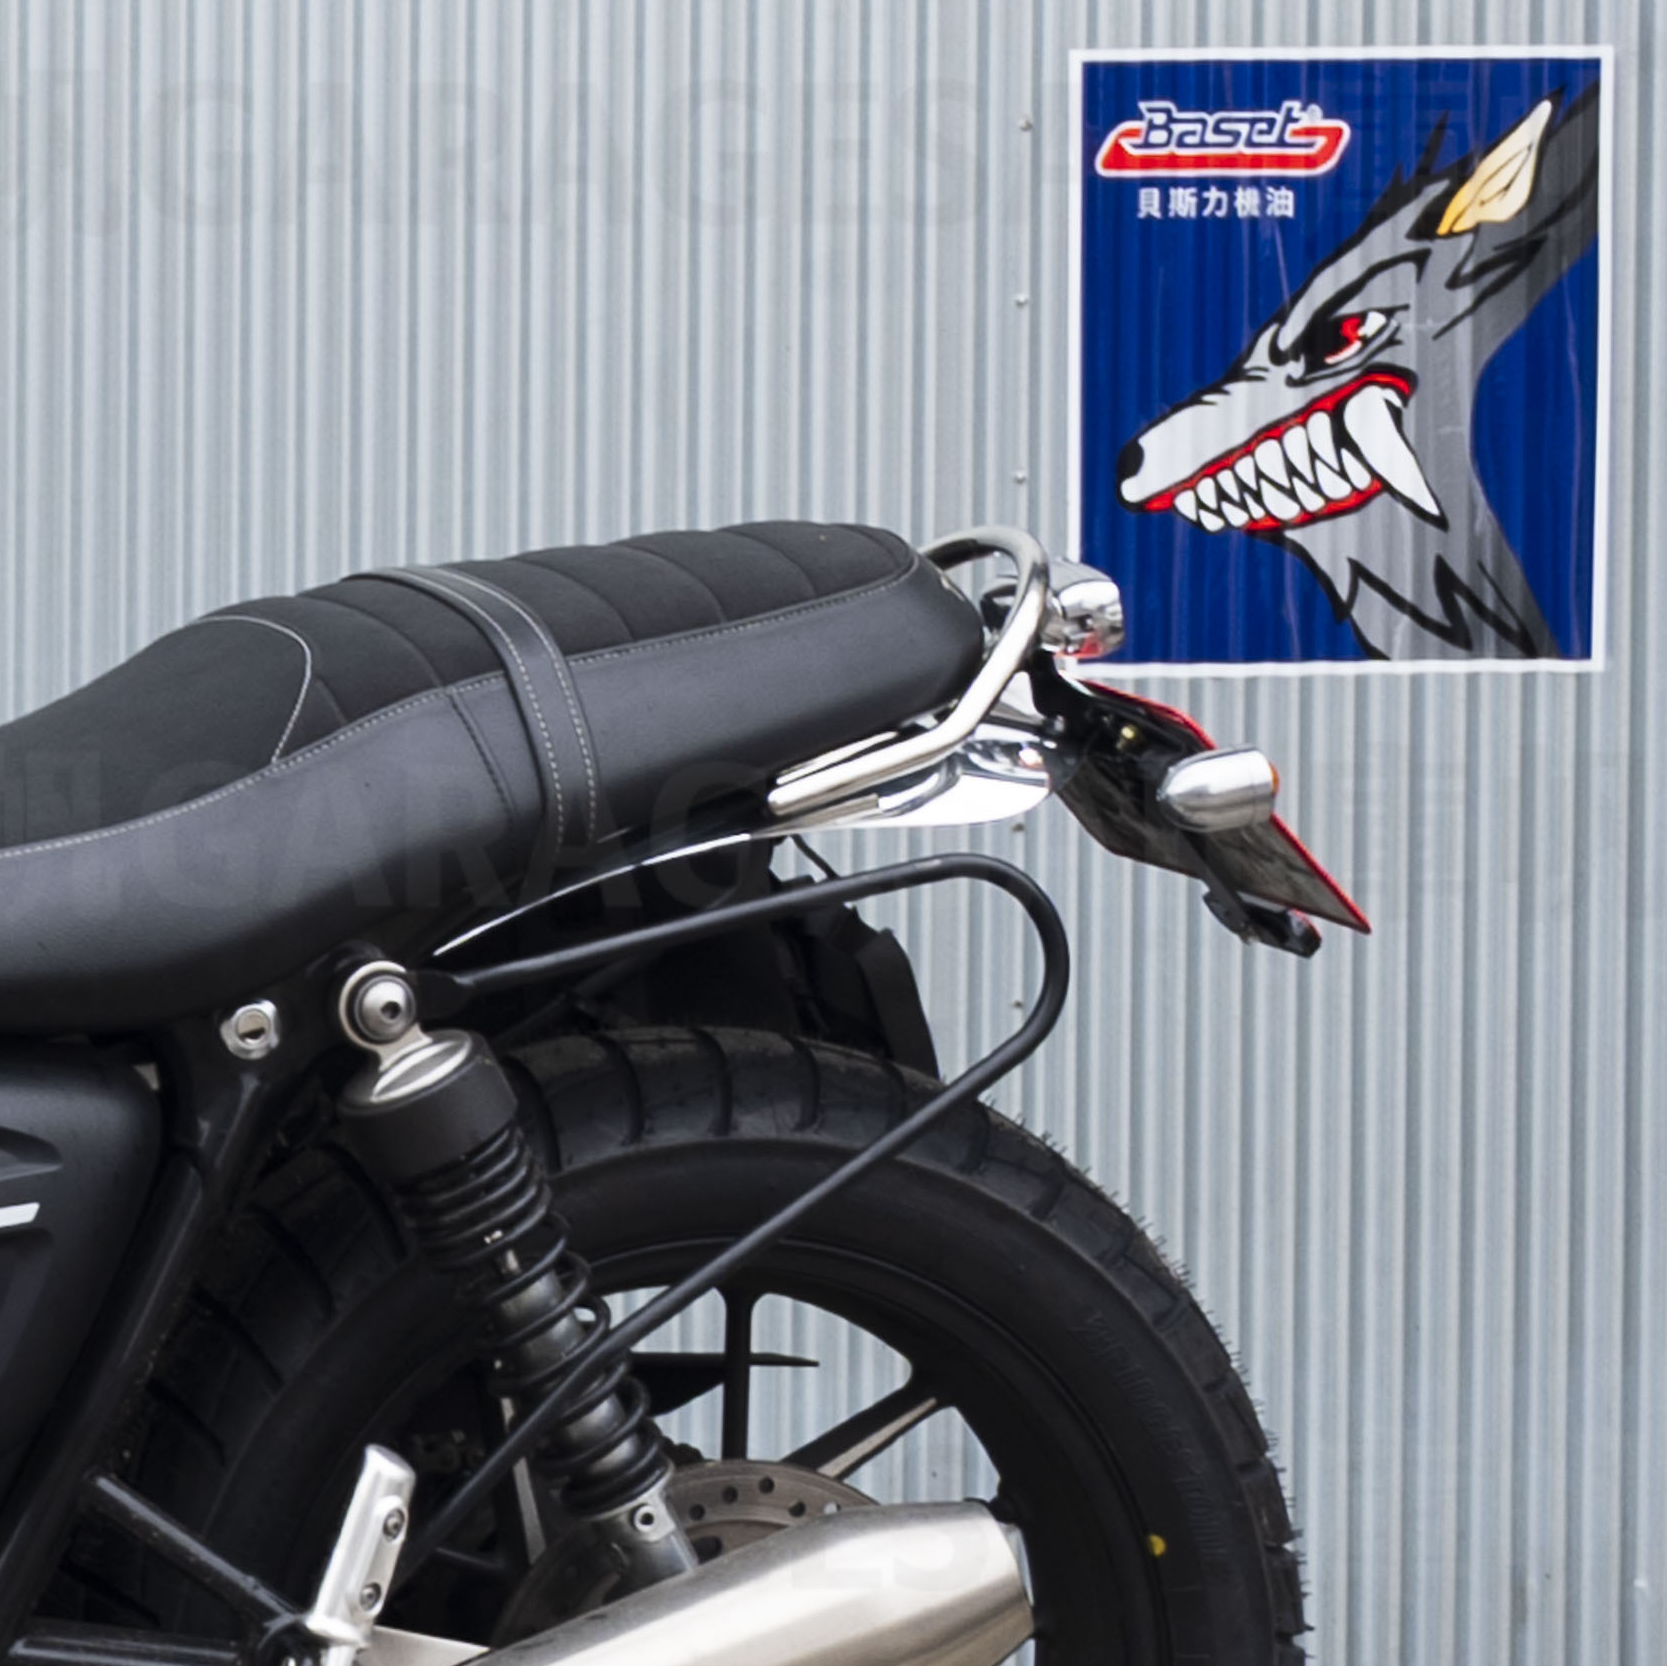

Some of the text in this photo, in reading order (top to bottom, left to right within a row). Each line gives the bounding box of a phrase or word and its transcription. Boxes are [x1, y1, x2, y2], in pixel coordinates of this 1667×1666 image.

[1137, 186, 1295, 219] 貝斯力機油
